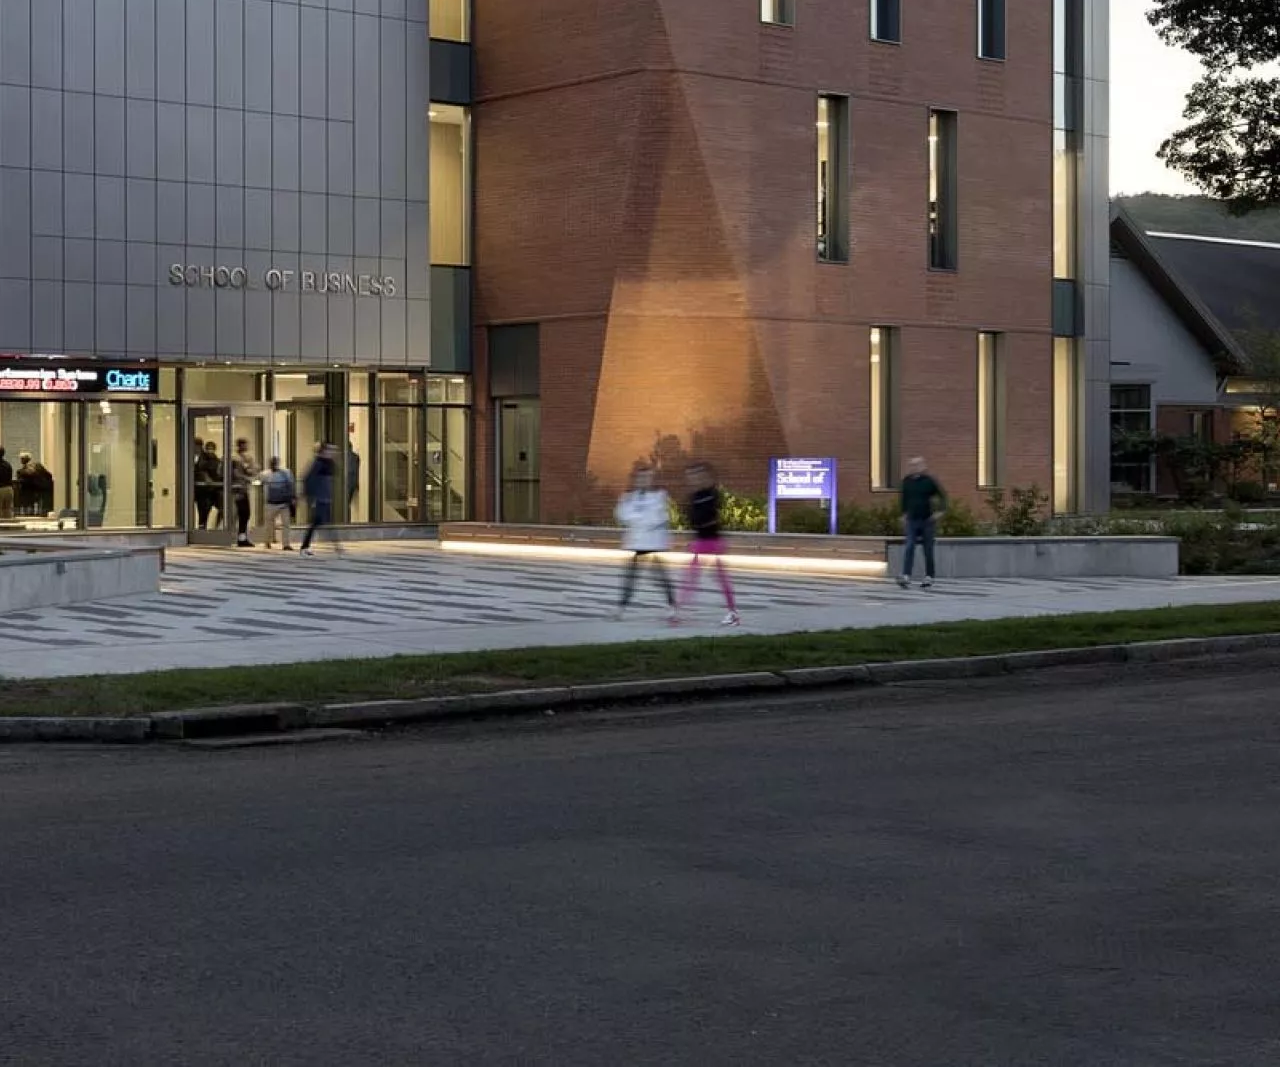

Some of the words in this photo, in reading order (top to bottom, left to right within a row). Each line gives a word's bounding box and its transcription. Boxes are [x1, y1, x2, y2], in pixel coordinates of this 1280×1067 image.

[169, 263, 258, 289] SCHOOL
[265, 268, 294, 291] OF
[302, 271, 397, 297] BUSINESS
